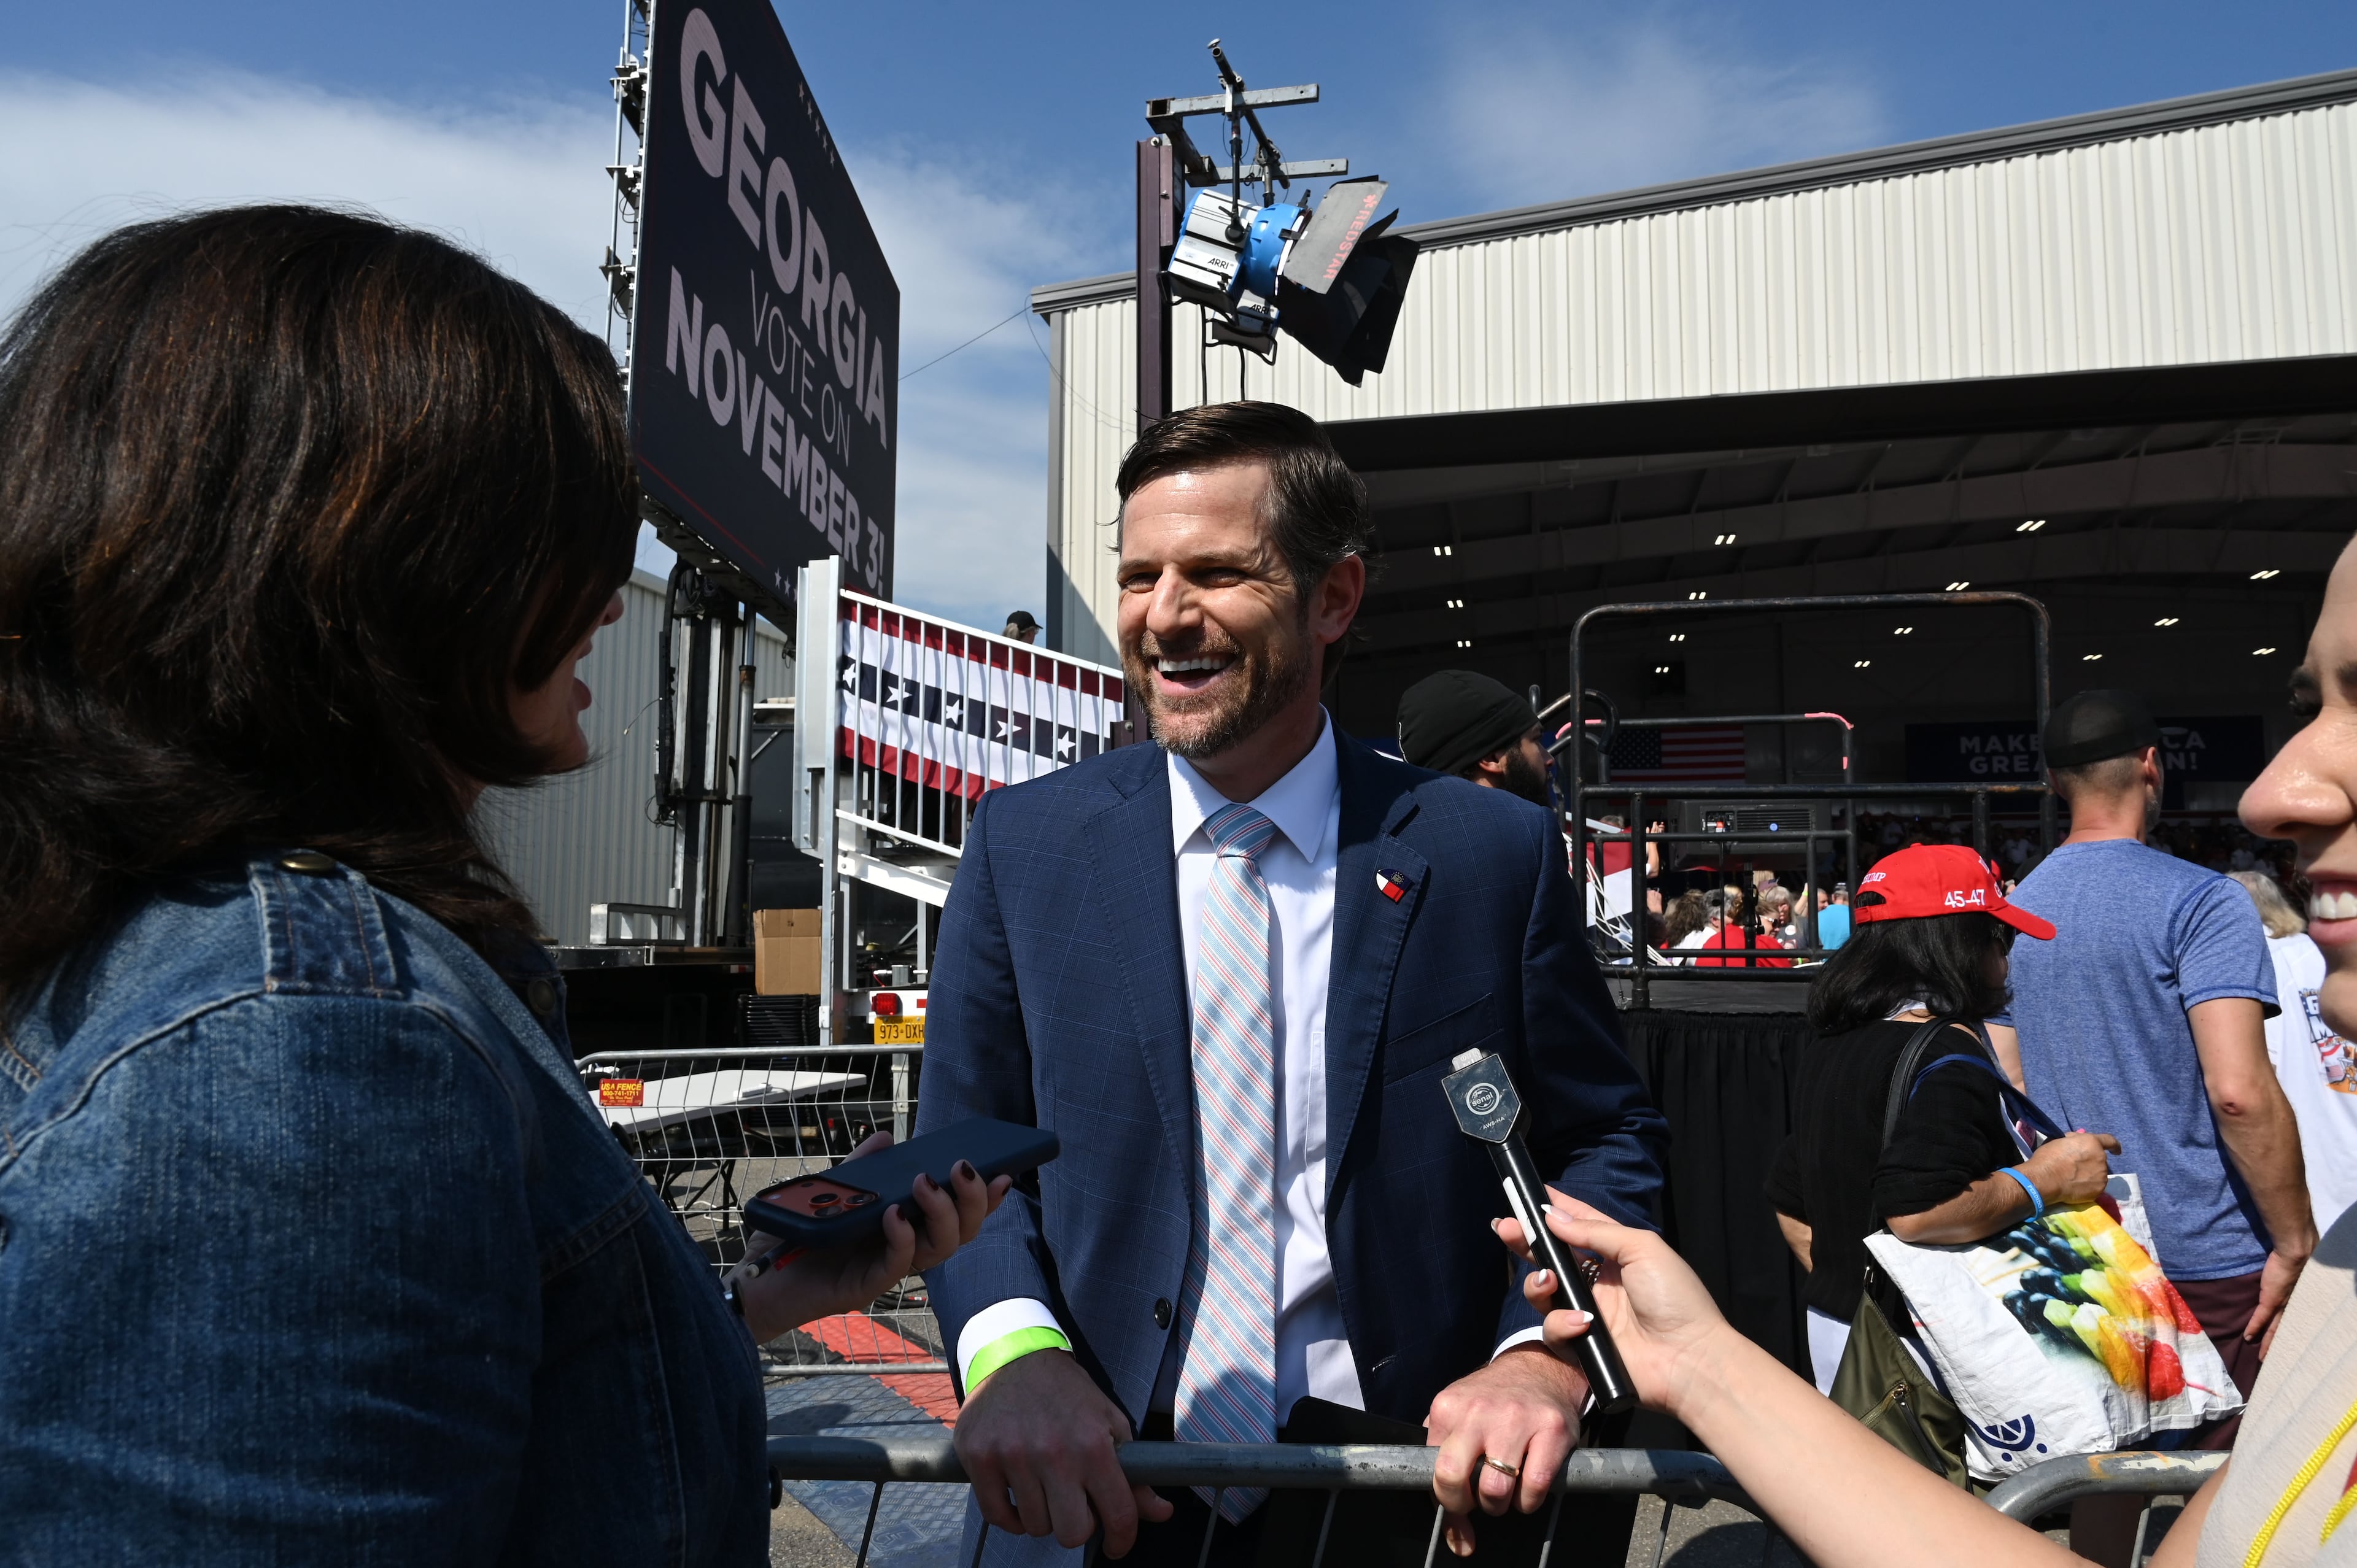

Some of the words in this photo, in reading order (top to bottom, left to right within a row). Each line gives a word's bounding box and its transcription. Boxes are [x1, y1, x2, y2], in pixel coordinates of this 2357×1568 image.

[680, 7, 888, 450] GEORGIA
[1323, 210, 1371, 280] REDSTAR
[1207, 258, 1229, 269] ARRI
[1248, 304, 1269, 315] ARRI
[751, 268, 815, 419] VOTE
[821, 382, 851, 467] ON
[666, 264, 860, 573] NOVEMBER
[865, 516, 885, 595] 3!
[1969, 755, 2038, 774] GRE
[1861, 871, 1886, 885] RUMP
[1945, 889, 1986, 908] 45-47
[880, 1024, 899, 1039] 973
[905, 1024, 924, 1038] DXH
[1471, 1092, 1493, 1107] senal
[1483, 1116, 1505, 1130] AWS-HA
